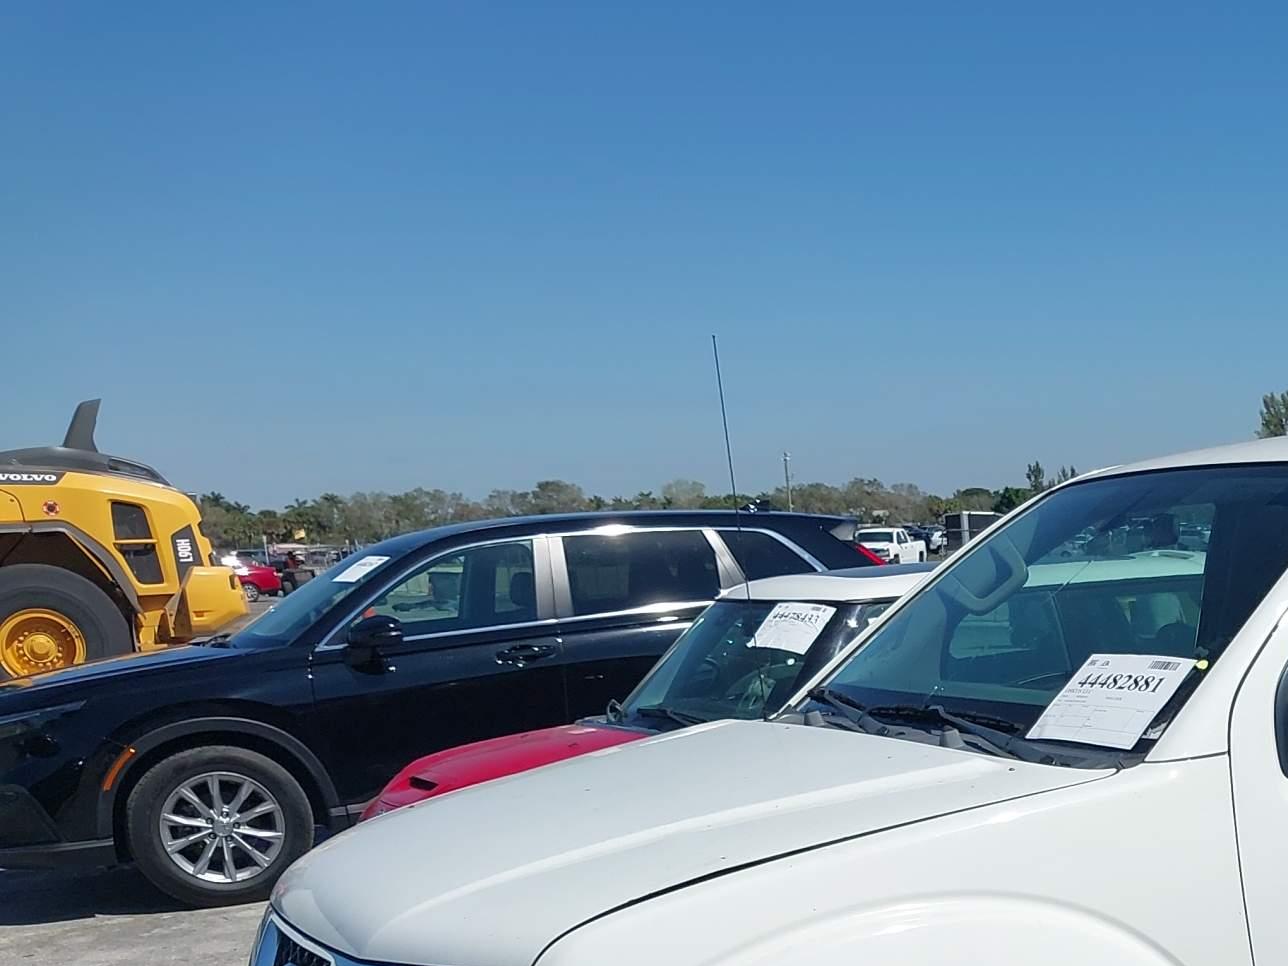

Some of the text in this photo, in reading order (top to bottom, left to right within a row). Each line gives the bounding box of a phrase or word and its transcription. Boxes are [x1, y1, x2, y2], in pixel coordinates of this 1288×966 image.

[0, 473, 57, 481] VOLVO
[175, 539, 193, 562] L90H
[1078, 672, 1165, 693] 44482881
